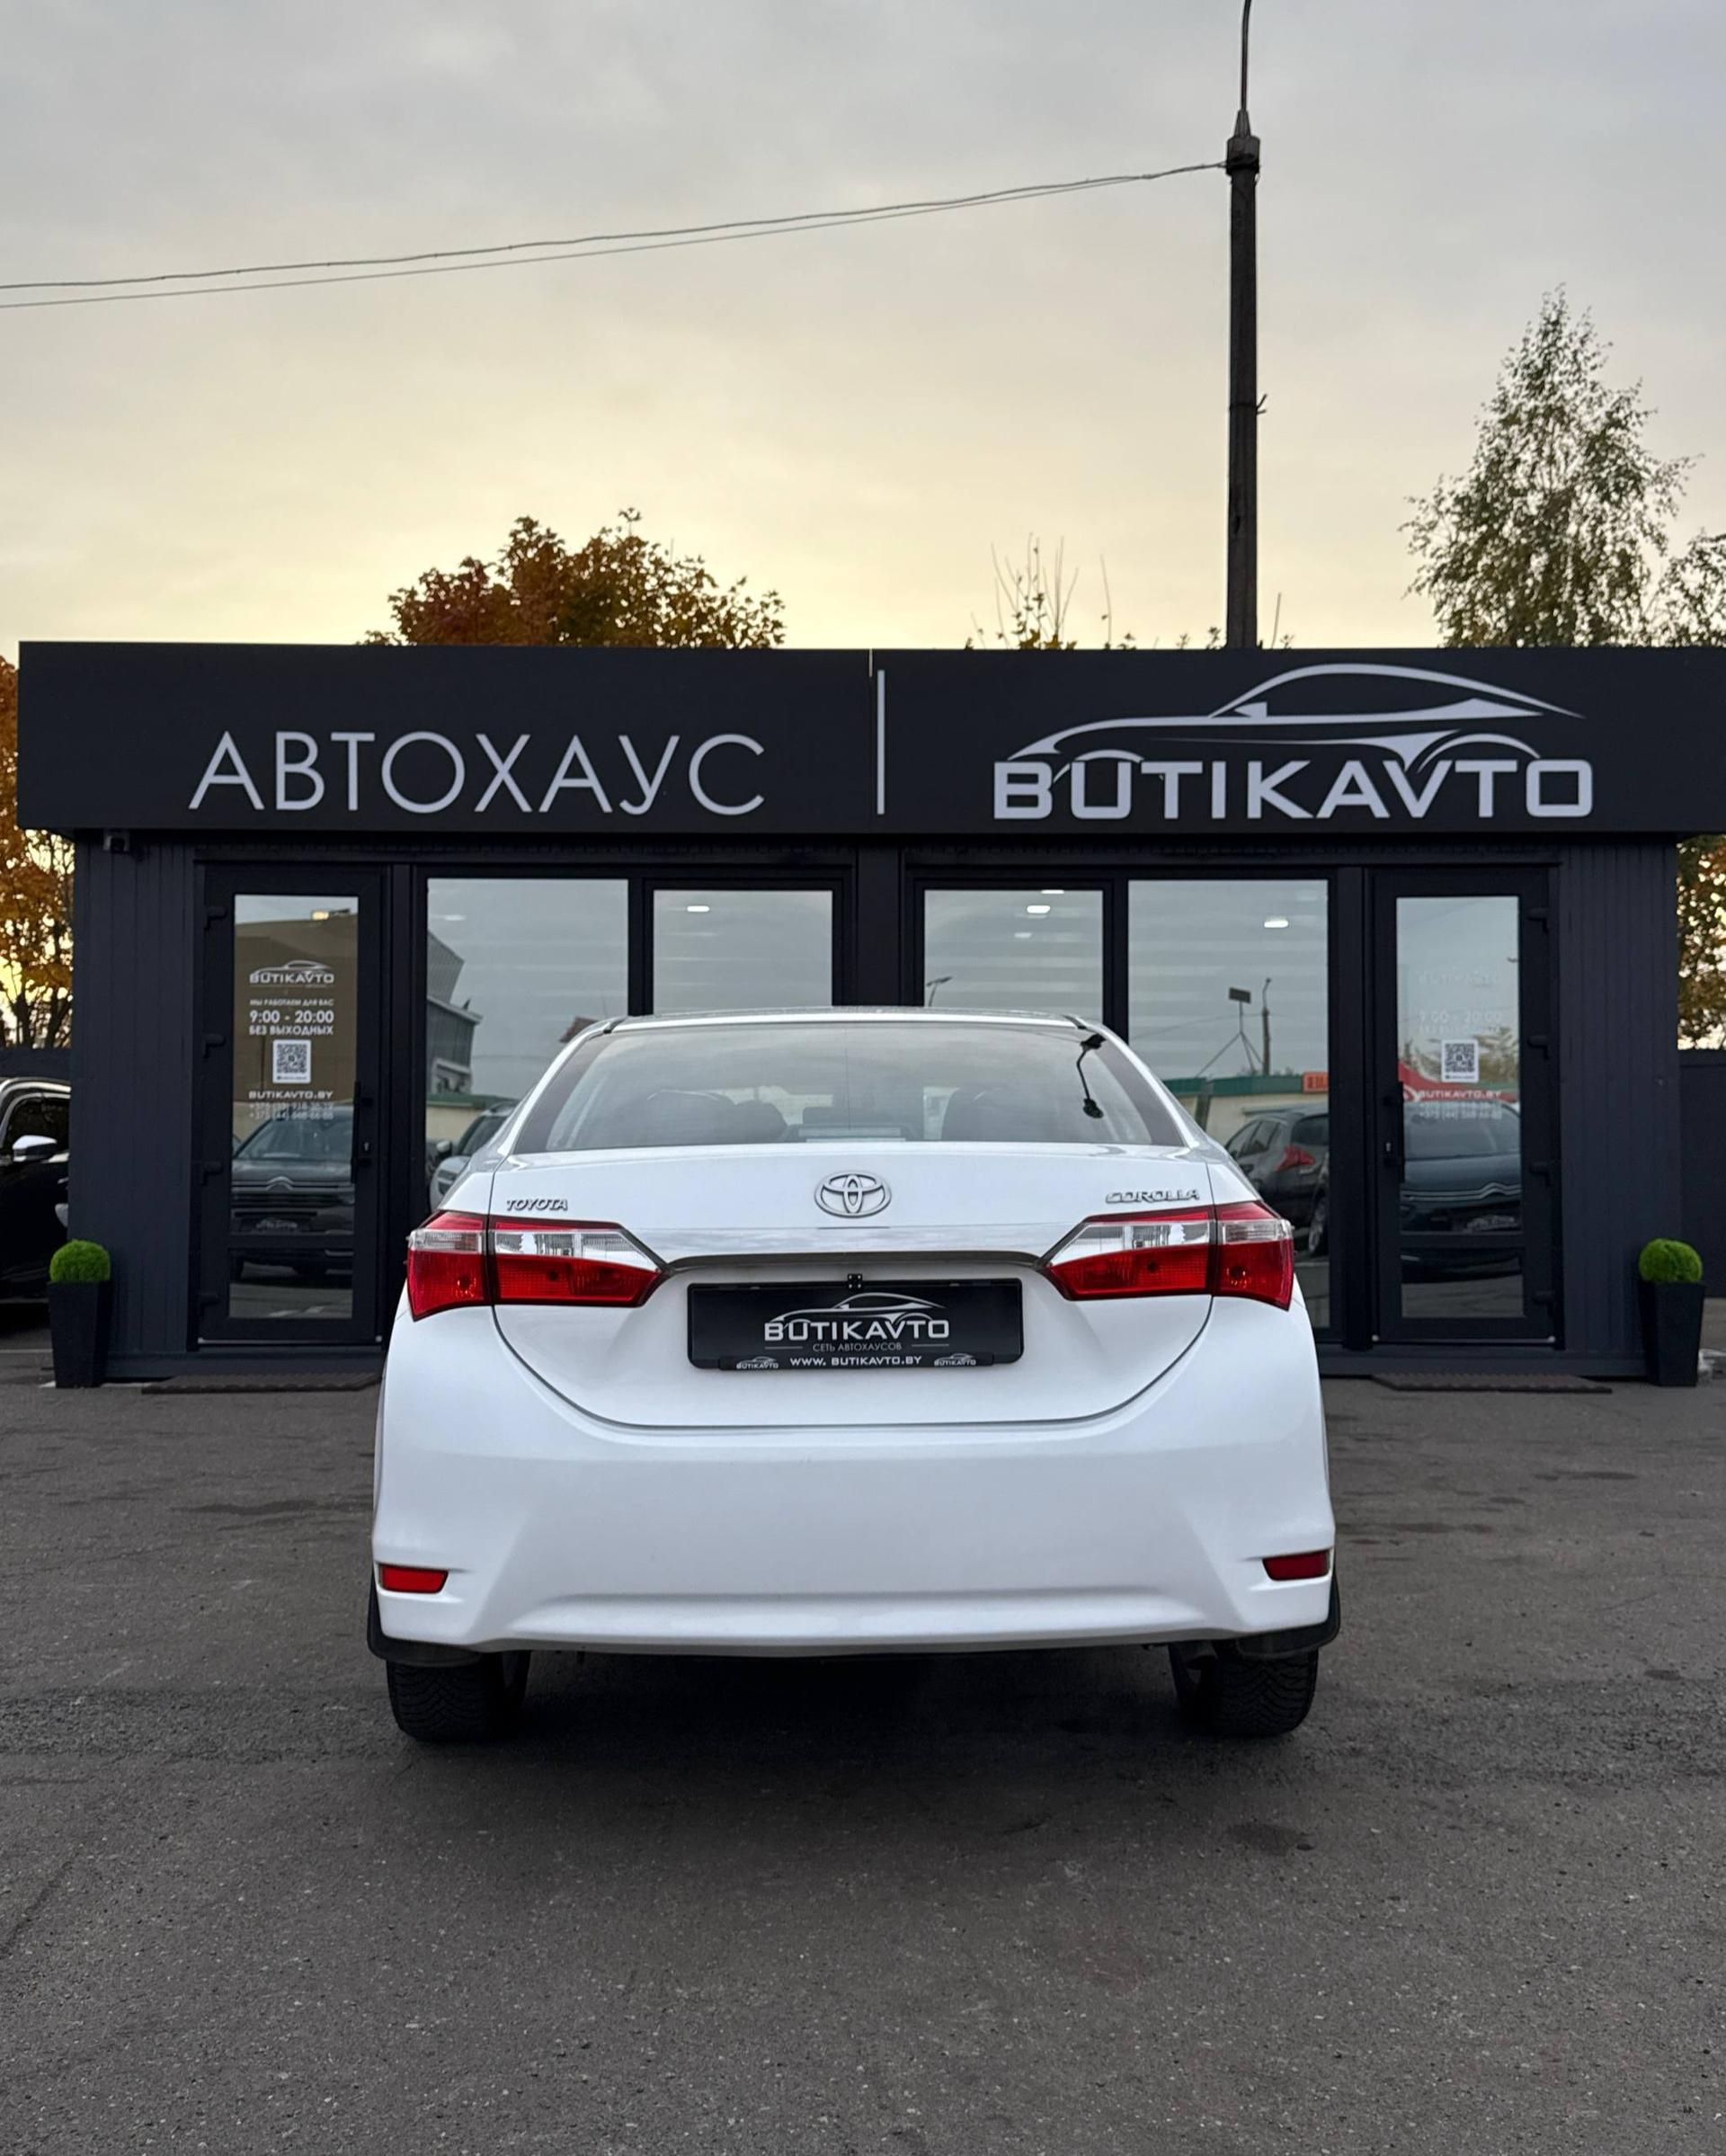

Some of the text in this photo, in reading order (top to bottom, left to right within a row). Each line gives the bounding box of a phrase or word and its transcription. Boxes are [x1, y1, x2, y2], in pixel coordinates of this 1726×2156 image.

[188, 730, 765, 817] АВТОХАУС
[993, 759, 1594, 820] BUTIKAVTO
[249, 973, 335, 984] BUTIKAVTO
[249, 1010, 280, 1023] 9:00
[294, 1010, 334, 1023] 20:00
[249, 1025, 334, 1036] БЕЗ ВЫХОДНЫХ
[248, 1091, 334, 1100] BUTIKAVTO.BY
[1419, 1090, 1502, 1099] BUTIKAVTO.BY
[1106, 1189, 1200, 1204] COROLLA
[506, 1198, 568, 1211] TOYOTA
[764, 1320, 950, 1341] BUTIKAVTO
[813, 1342, 902, 1352] СЕТЬ АВТОХАУСОВ
[790, 1355, 922, 1367] WWW. BUTIKAVTO.BY
